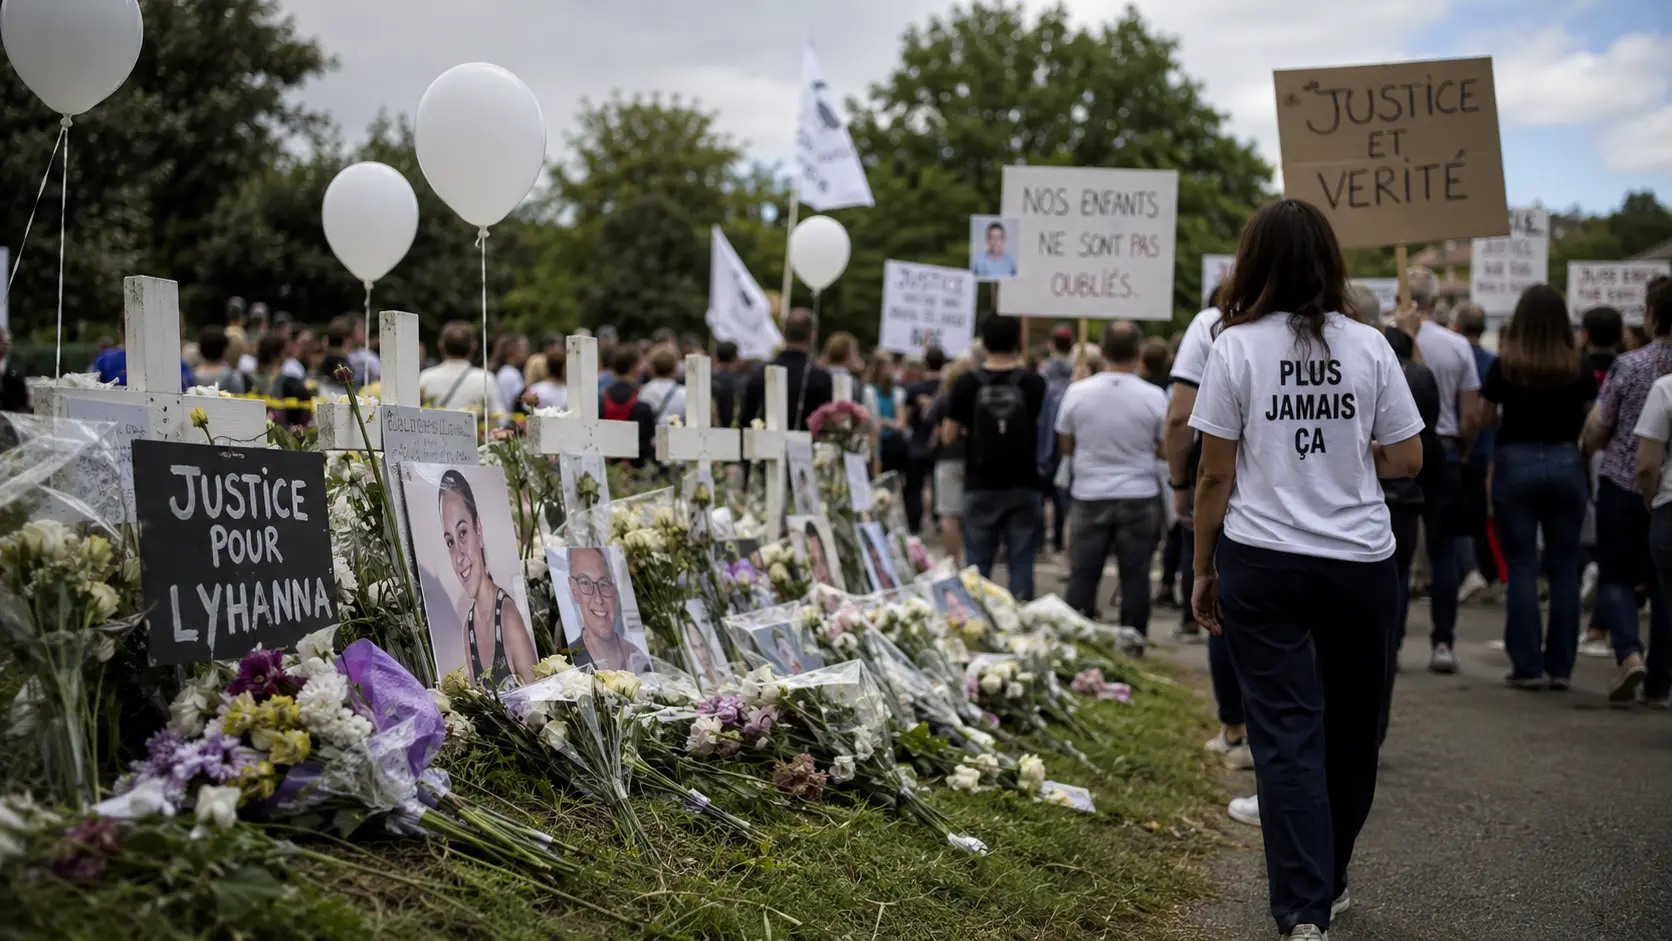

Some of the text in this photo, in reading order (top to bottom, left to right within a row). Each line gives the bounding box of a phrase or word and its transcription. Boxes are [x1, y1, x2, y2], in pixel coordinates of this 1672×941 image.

[1368, 128, 1408, 159] ET
[1317, 149, 1468, 210] VERITÉ
[1022, 186, 1160, 219] NOS ENFANTS
[1038, 230, 1161, 259] NE SONT PAS
[1280, 360, 1342, 386] PLUS
[1265, 393, 1356, 421] JAMAIS
[1295, 428, 1326, 460] ÇA
[209, 524, 284, 568] POUR
[169, 577, 334, 650] LYHANNA
